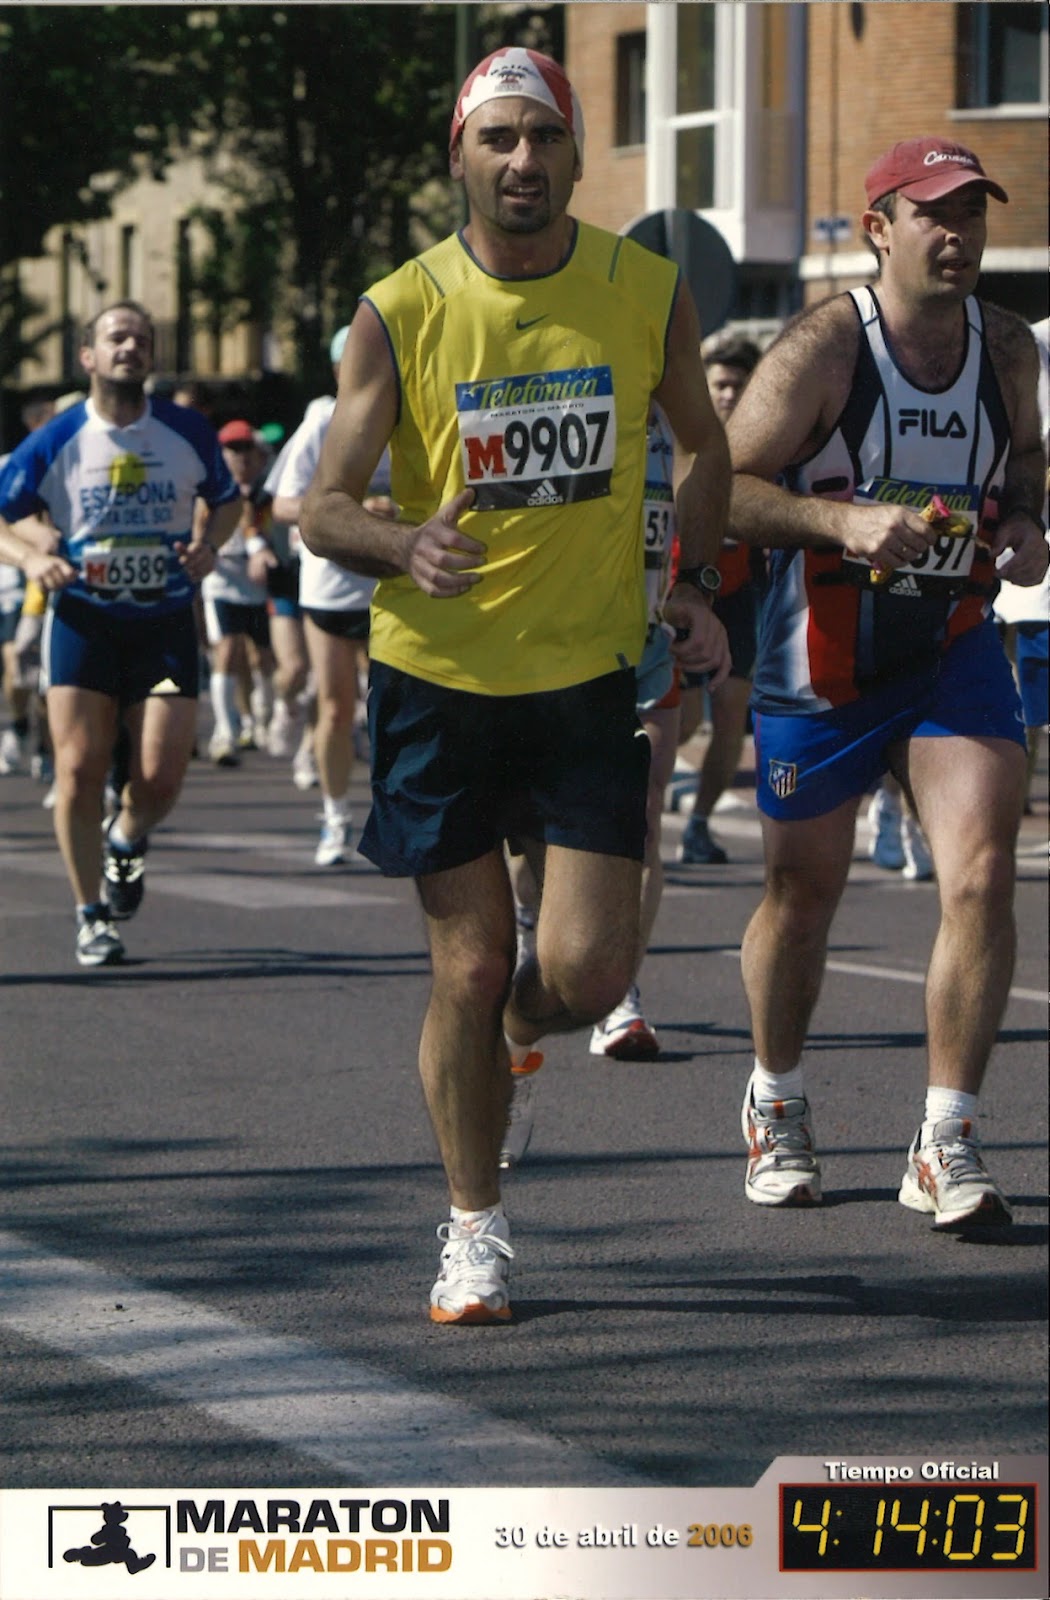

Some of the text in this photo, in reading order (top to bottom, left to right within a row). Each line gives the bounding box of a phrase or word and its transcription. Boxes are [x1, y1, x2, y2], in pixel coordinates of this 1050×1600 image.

[898, 408, 967, 438] FILA
[80, 479, 177, 507] ESTEPONA
[527, 495, 563, 506] adidas
[889, 586, 922, 597] adidas
